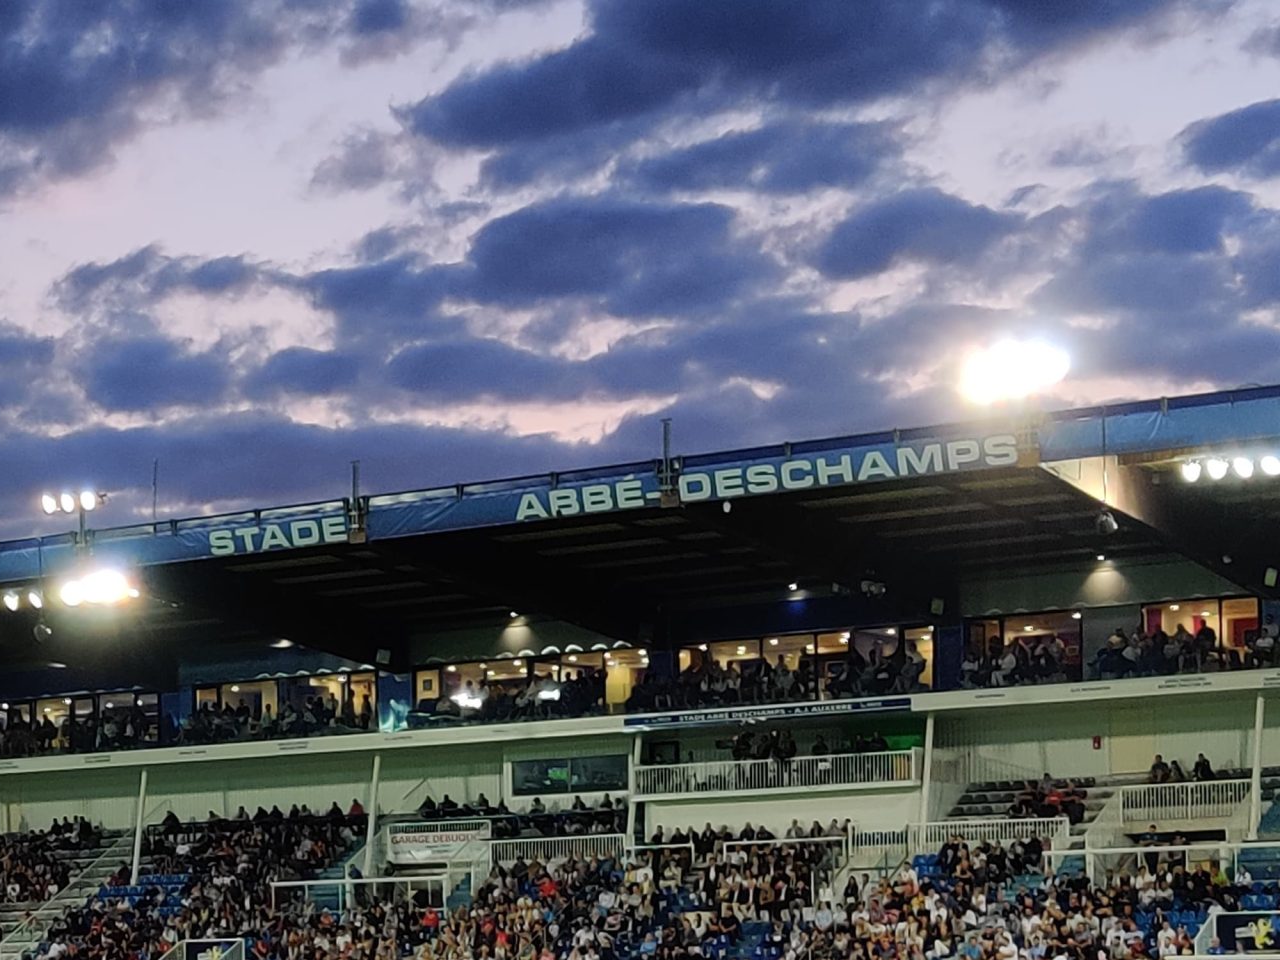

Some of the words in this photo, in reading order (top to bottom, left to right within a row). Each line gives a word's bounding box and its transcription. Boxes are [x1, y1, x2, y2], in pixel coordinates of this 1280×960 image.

[209, 517, 347, 556] STADE
[811, 703, 853, 712] AUXERRE
[391, 835, 430, 845] GARAGE
